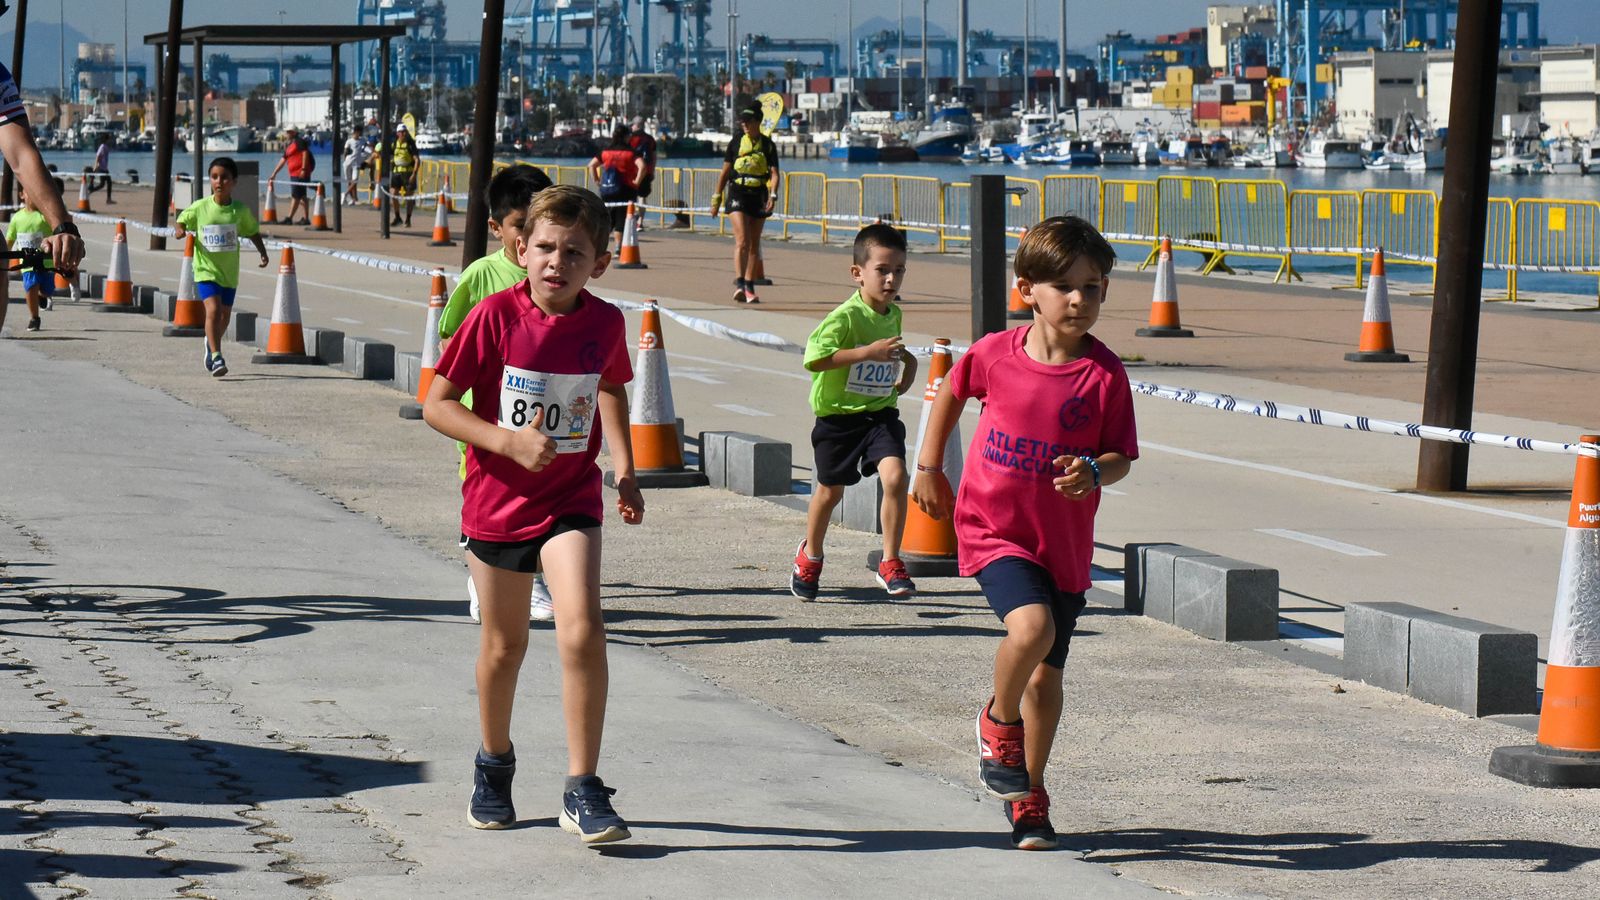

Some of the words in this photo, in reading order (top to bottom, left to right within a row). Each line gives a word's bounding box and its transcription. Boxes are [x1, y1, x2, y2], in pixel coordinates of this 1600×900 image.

[204, 234, 226, 245] 1094
[855, 363, 892, 383] 1202
[507, 374, 526, 389] XXI
[525, 378, 546, 387] Carrera
[525, 384, 546, 393] Popular
